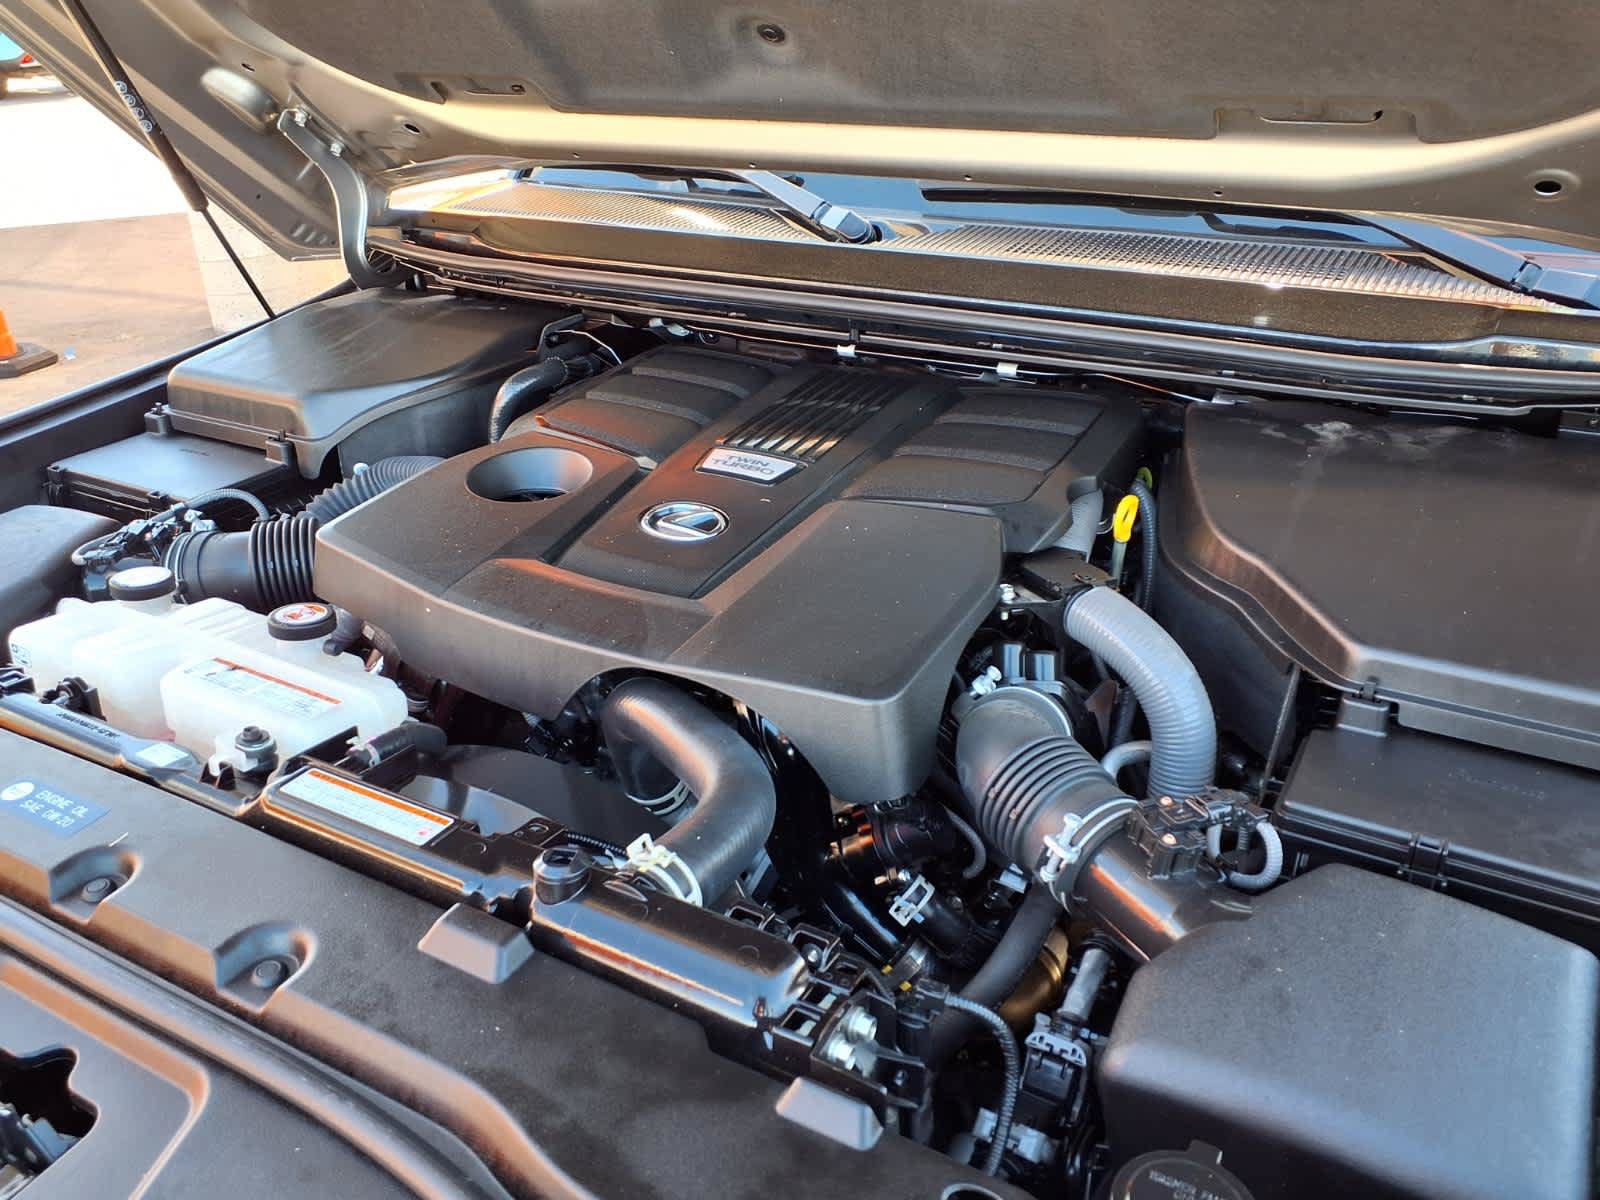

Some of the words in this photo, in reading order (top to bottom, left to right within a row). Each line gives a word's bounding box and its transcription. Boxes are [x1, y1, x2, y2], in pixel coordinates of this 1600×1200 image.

[711, 458, 776, 475] TURBO
[728, 455, 770, 467] TWIN
[19, 799, 45, 814] SAE
